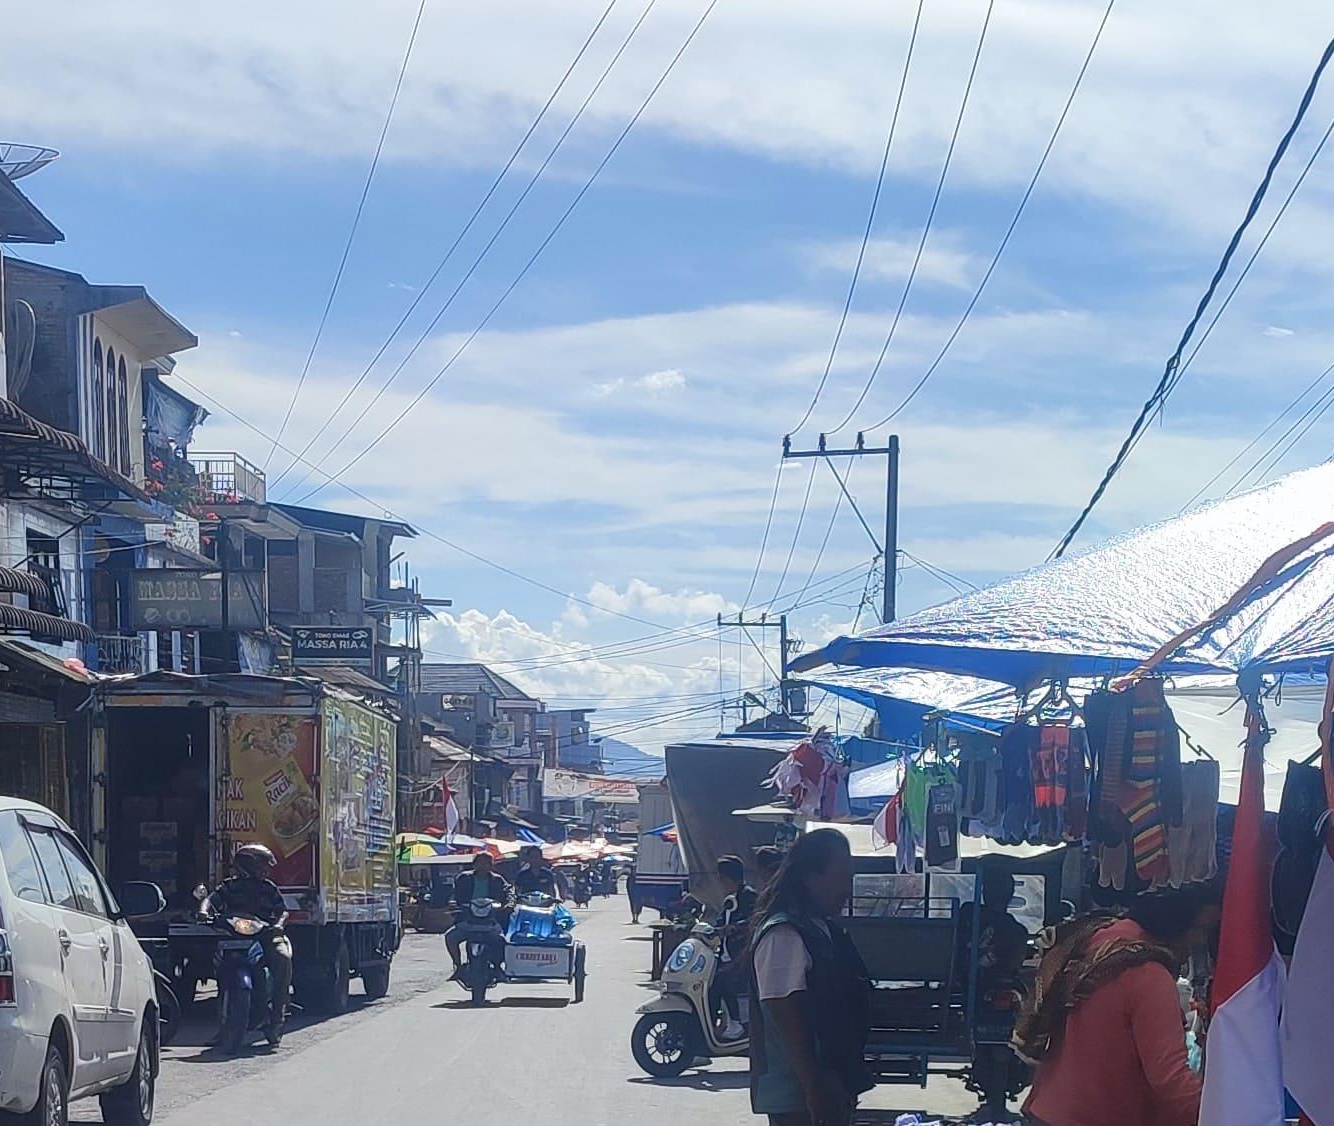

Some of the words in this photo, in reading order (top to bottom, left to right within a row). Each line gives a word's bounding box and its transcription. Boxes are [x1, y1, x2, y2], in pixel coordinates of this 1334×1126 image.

[297, 640, 337, 649] MASSA
[339, 640, 358, 649] RIA
[266, 776, 294, 805] Racik
